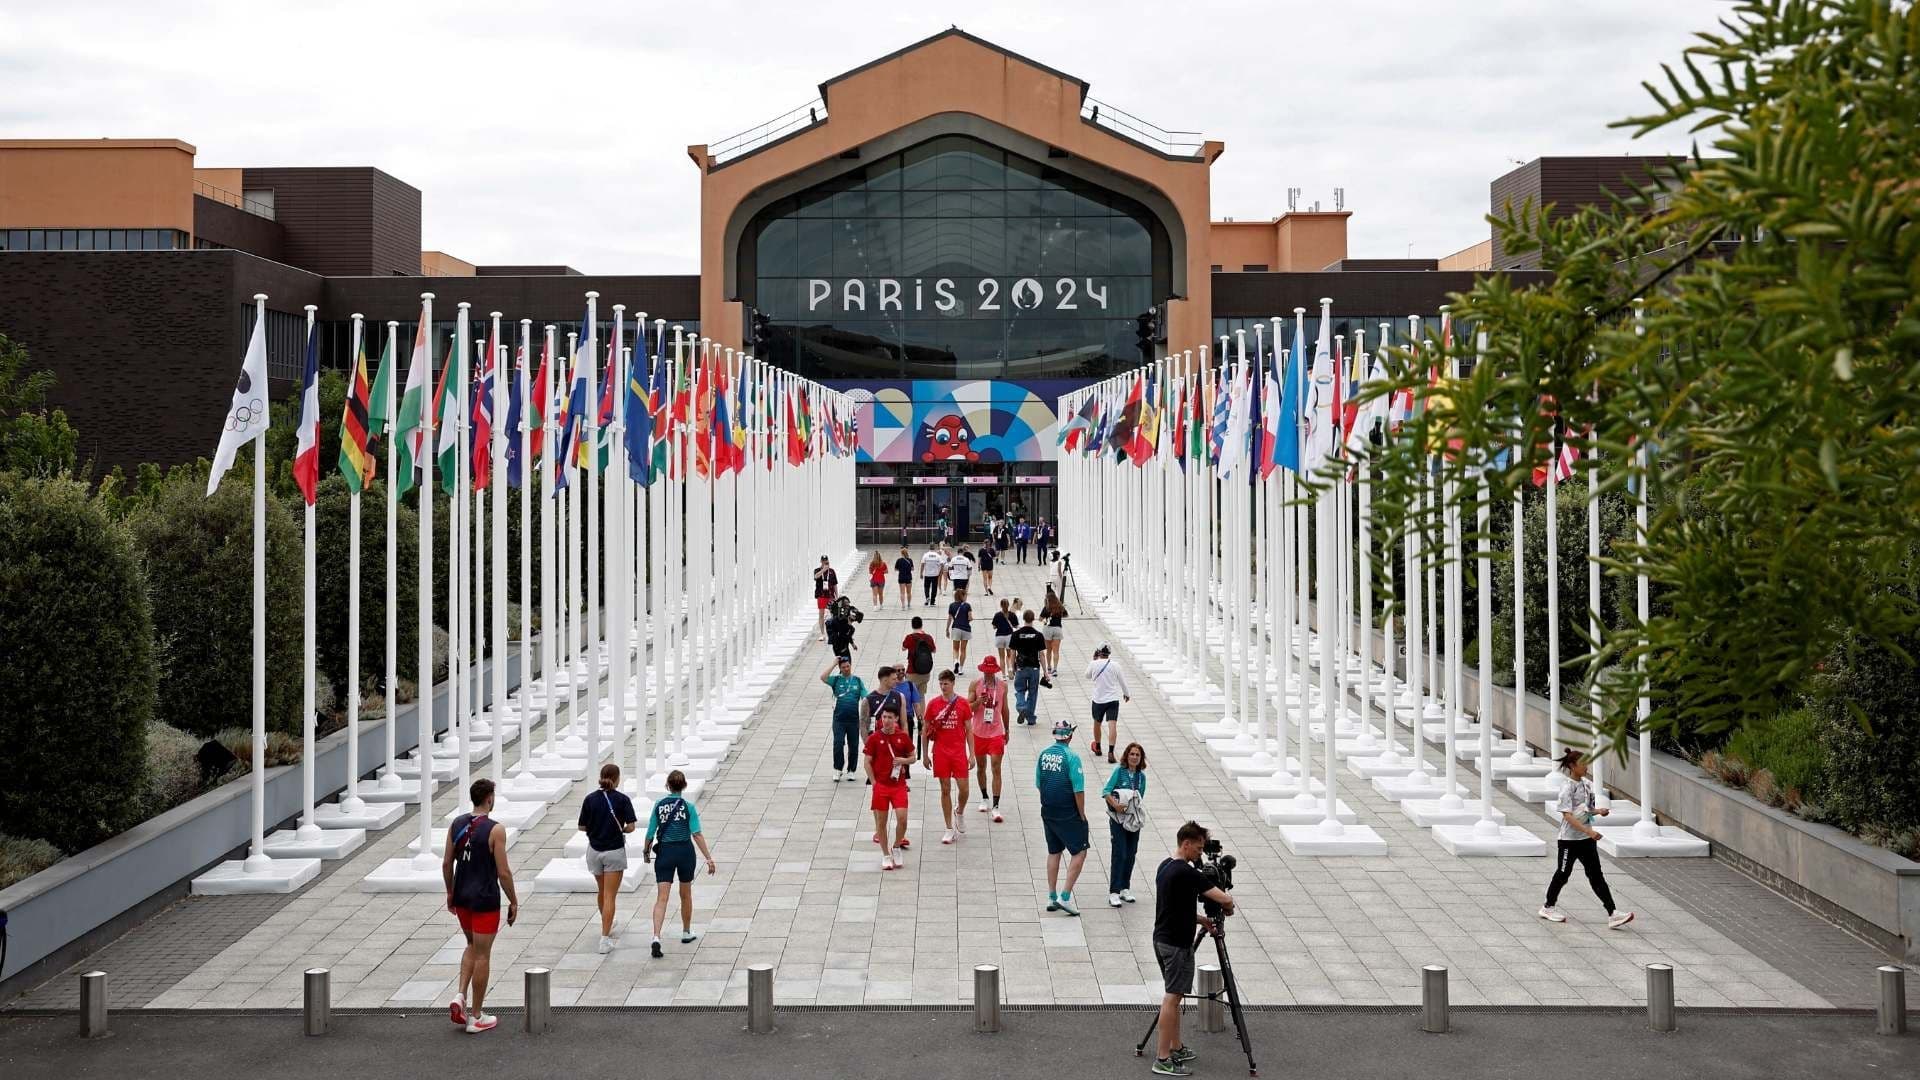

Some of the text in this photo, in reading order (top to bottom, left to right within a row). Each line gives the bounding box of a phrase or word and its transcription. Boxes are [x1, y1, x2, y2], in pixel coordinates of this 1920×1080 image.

[978, 278, 1107, 311] 2024
[1042, 762, 1061, 772] 2024
[658, 803, 685, 815] PARS
